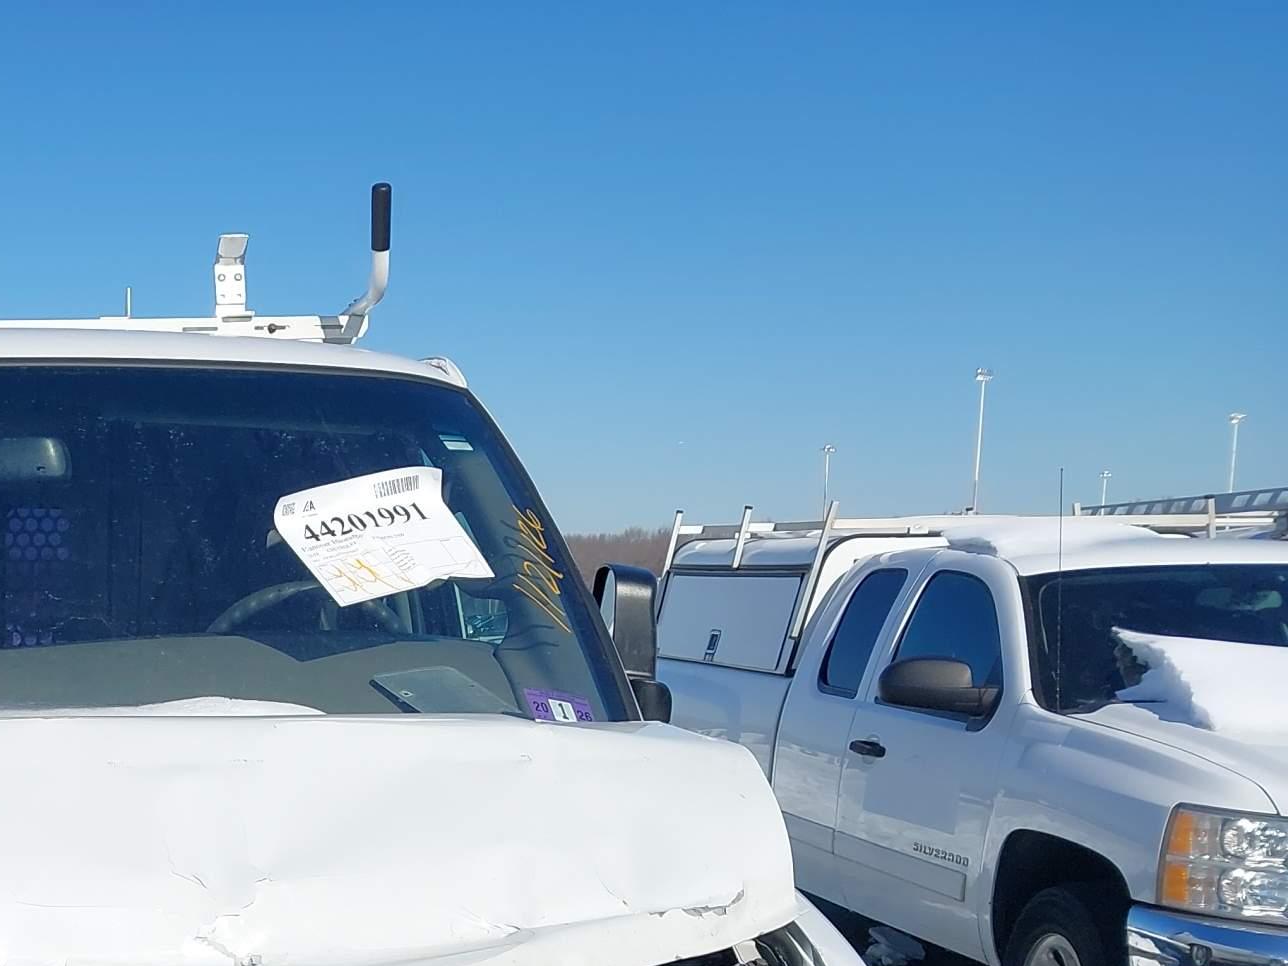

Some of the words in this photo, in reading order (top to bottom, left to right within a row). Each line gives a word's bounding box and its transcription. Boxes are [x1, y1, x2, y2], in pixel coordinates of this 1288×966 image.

[304, 502, 431, 542] 44201991
[533, 701, 549, 713] 20
[558, 703, 569, 720] 1
